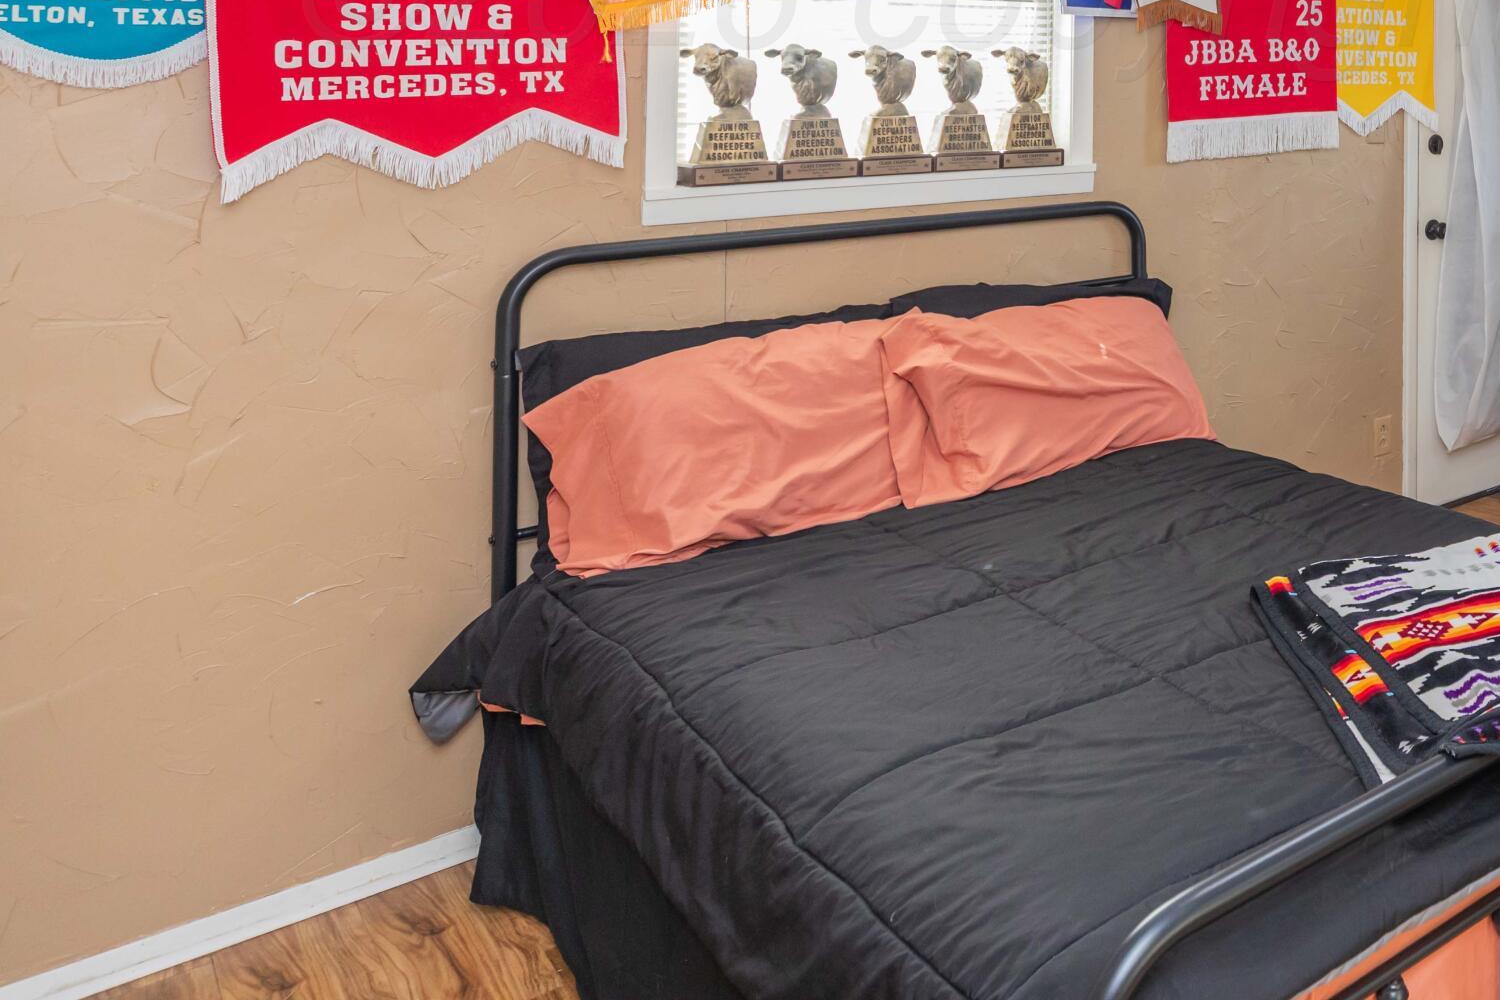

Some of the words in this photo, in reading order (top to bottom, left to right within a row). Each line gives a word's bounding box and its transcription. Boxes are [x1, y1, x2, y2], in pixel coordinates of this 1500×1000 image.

[113, 7, 204, 25] TEXAS
[340, 3, 472, 31] SHOW
[488, 4, 512, 28] &
[1296, 0, 1323, 26] 25
[1385, 30, 1396, 46] &
[274, 38, 567, 69] CONVENTION
[1185, 39, 1257, 65] JBBA
[1268, 37, 1320, 62] B&O
[1397, 72, 1414, 85] TX
[281, 73, 507, 101] MERCEDES,
[520, 71, 564, 92] TX
[1200, 72, 1306, 101] FEMALE
[880, 118, 907, 127] JUNIOR
[953, 116, 976, 124] JUNIOR
[1019, 115, 1041, 123] JUNIOR
[718, 123, 749, 131] JUNIOR
[801, 120, 829, 129] JUNIOR
[1012, 123, 1049, 131] BEEFMASTER
[792, 129, 840, 139] BEEFMASTER
[873, 127, 916, 136] BEEFMASTER
[1016, 131, 1046, 139] BREEDERS
[708, 132, 760, 141] BEEFMASTER
[877, 137, 912, 145] BREEDERS
[949, 134, 981, 142] BREEDERS
[713, 142, 755, 150] BREEDERS
[796, 138, 835, 148] BREEDERS
[944, 143, 988, 151] ASSOCIATION
[1011, 139, 1052, 147] ASSOCIATION
[790, 148, 844, 158] ASSOCIATION
[872, 144, 919, 154] ASSOCIATION
[706, 151, 764, 161] ASSOCIATION
